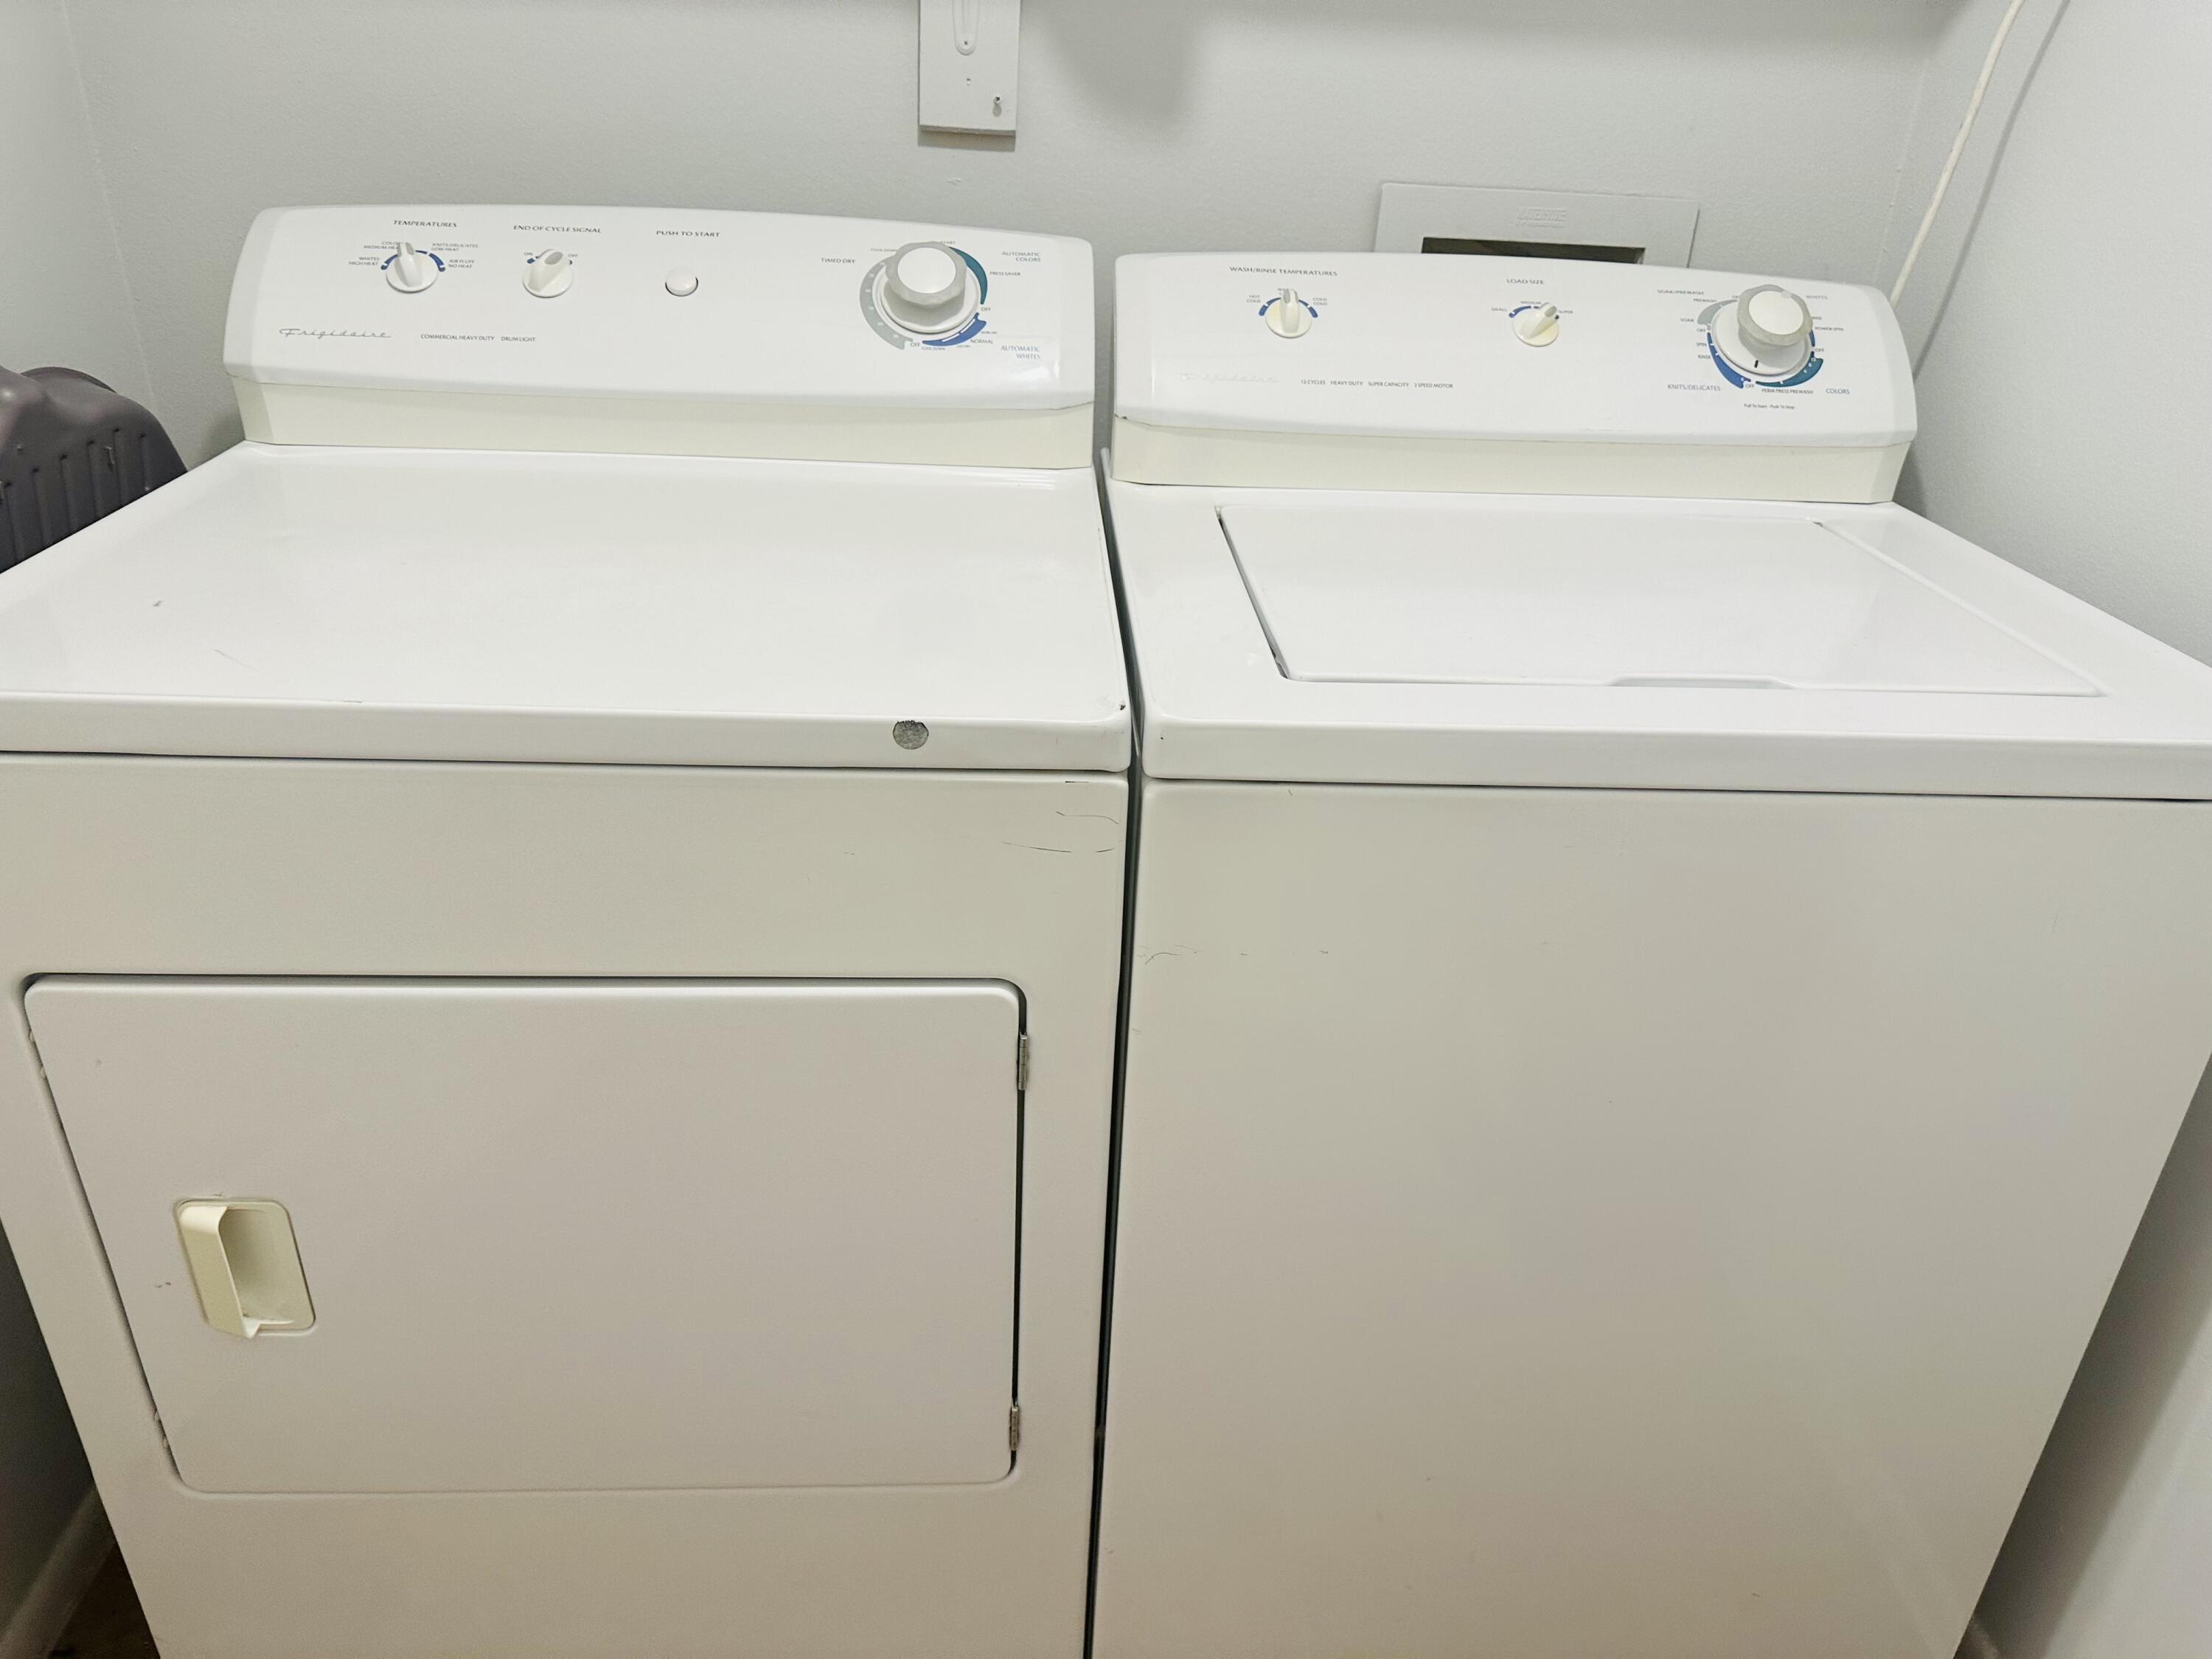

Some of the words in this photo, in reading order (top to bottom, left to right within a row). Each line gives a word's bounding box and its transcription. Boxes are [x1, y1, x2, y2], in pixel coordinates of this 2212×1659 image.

[393, 220, 457, 228] TEMPERATURES
[1279, 268, 1338, 276] TEMPERATURES
[279, 327, 392, 339] Frigidaire
[1001, 344, 1041, 352] AUTOMATIC
[1667, 383, 1721, 392] KNITS/DELICATES
